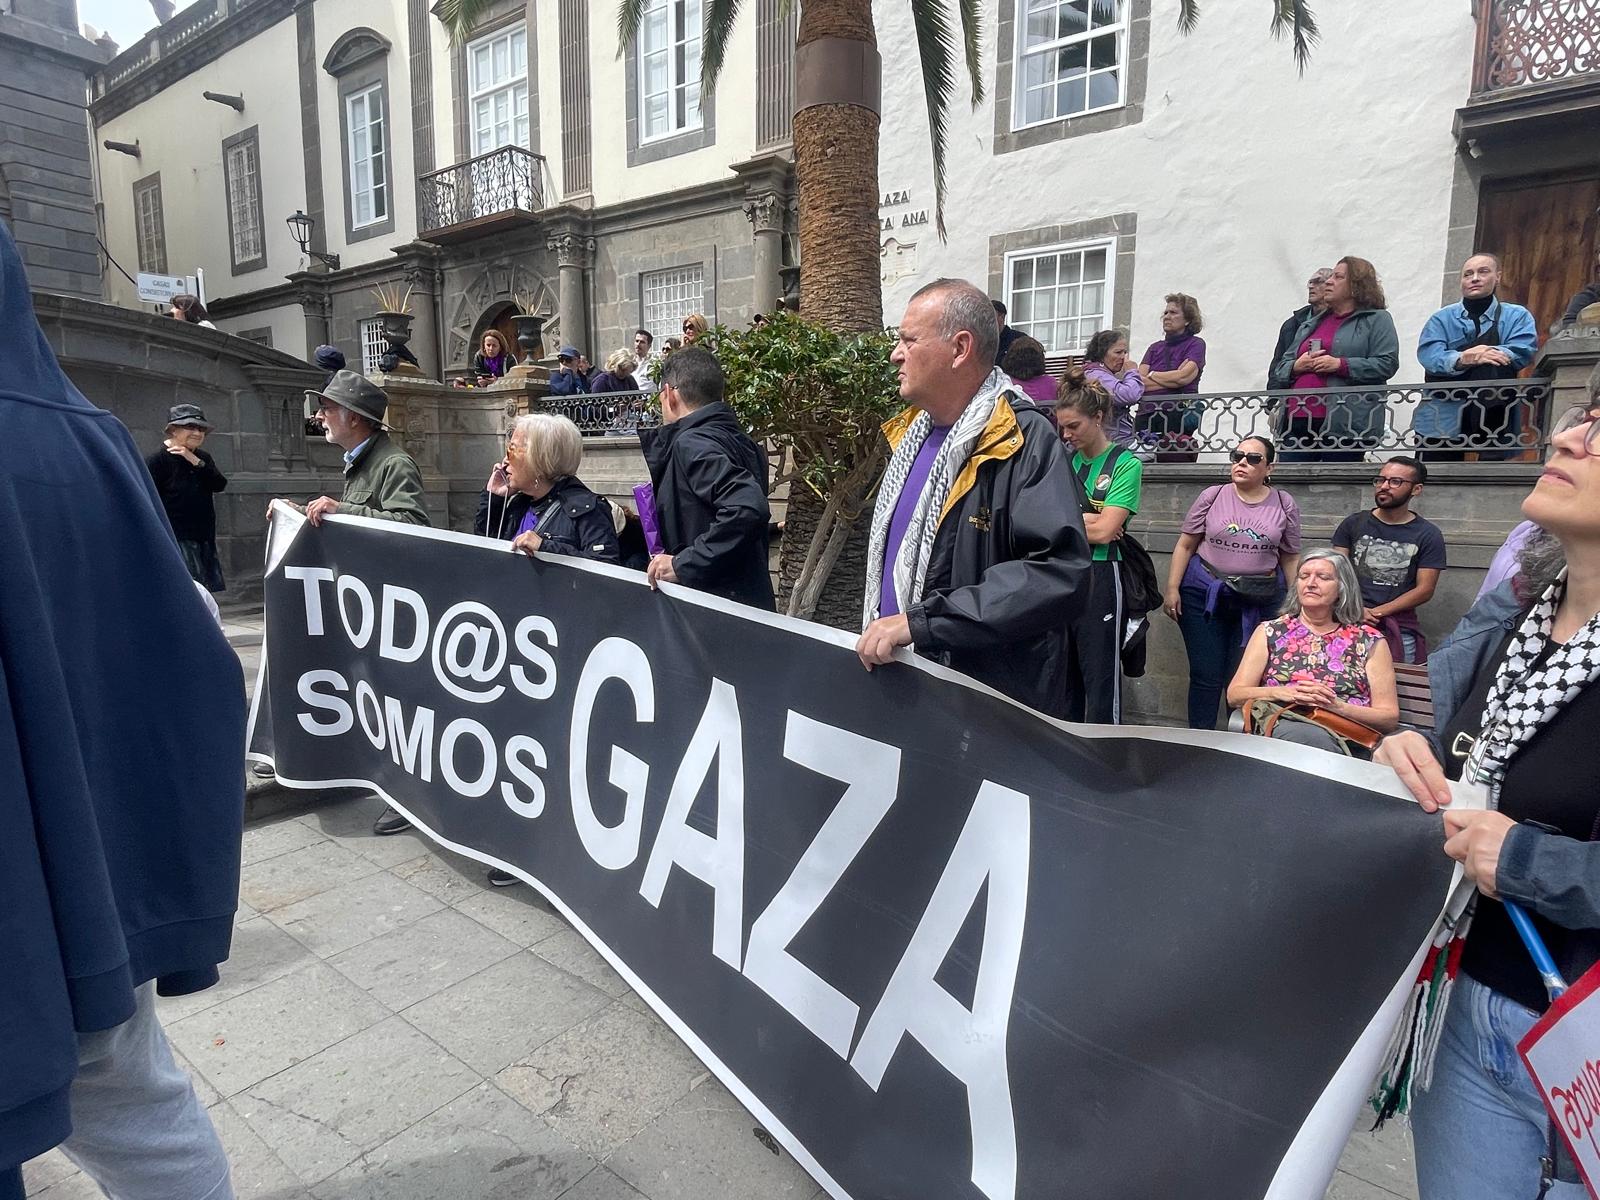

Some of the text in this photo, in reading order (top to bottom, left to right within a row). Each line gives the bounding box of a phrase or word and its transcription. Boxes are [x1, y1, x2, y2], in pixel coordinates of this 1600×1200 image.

[902, 210, 928, 228] ANA
[285, 566, 558, 703] TOD@S
[297, 670, 548, 819] SOMOS
[570, 636, 1031, 1200] GAZA
